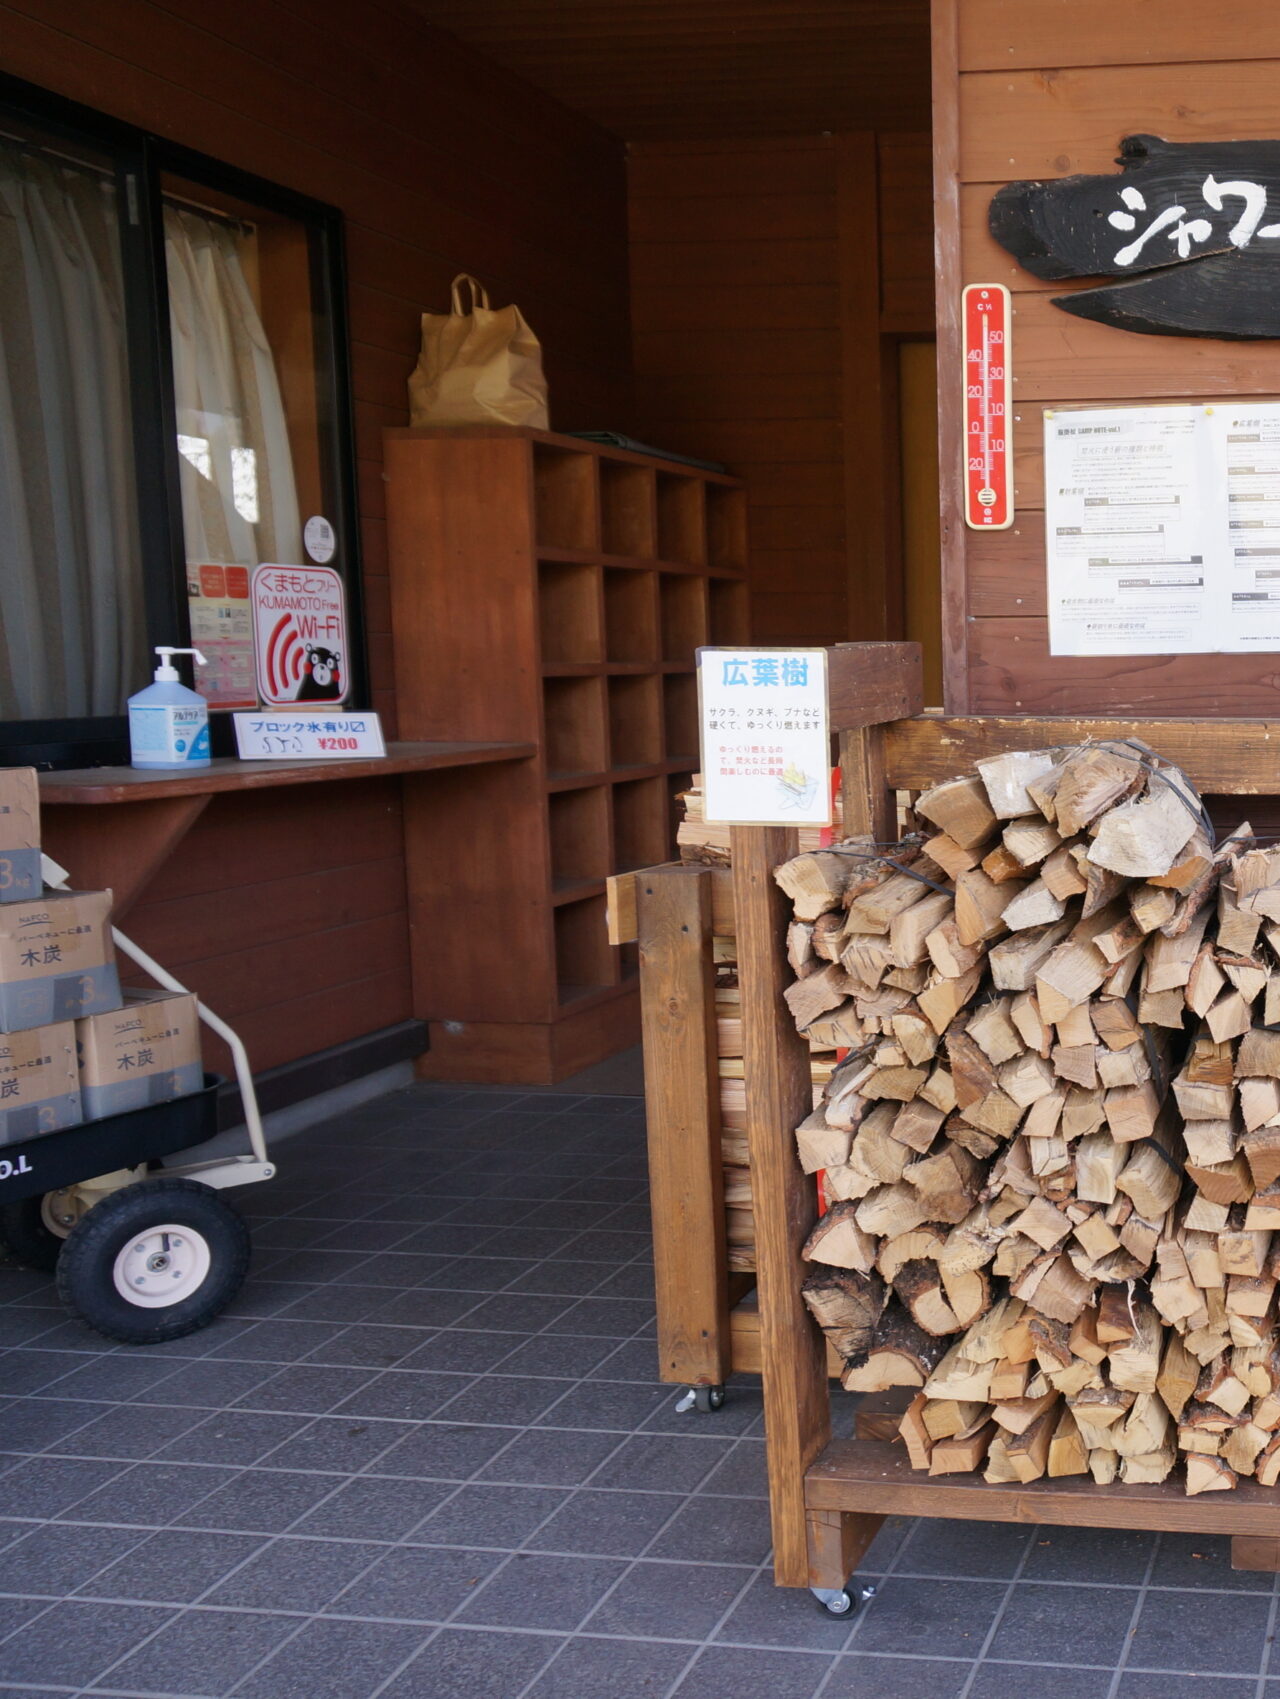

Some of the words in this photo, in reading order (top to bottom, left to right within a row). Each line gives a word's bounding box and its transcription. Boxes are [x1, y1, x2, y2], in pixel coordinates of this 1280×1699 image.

[989, 330, 1004, 341] 50
[968, 349, 983, 360] 40
[989, 366, 1004, 378] 30
[968, 385, 983, 396] 20
[991, 403, 1004, 415] 10
[971, 421, 980, 433] 0
[991, 439, 1005, 450] 10
[969, 457, 984, 469] 20
[259, 595, 320, 610] KUMAMOTO
[321, 599, 340, 611] Free
[296, 614, 341, 640] Wi-Fi
[721, 657, 809, 687] 広葉樹
[317, 737, 358, 750] ¥200
[20, 944, 62, 968] 木炭
[117, 1048, 154, 1071] 木炭
